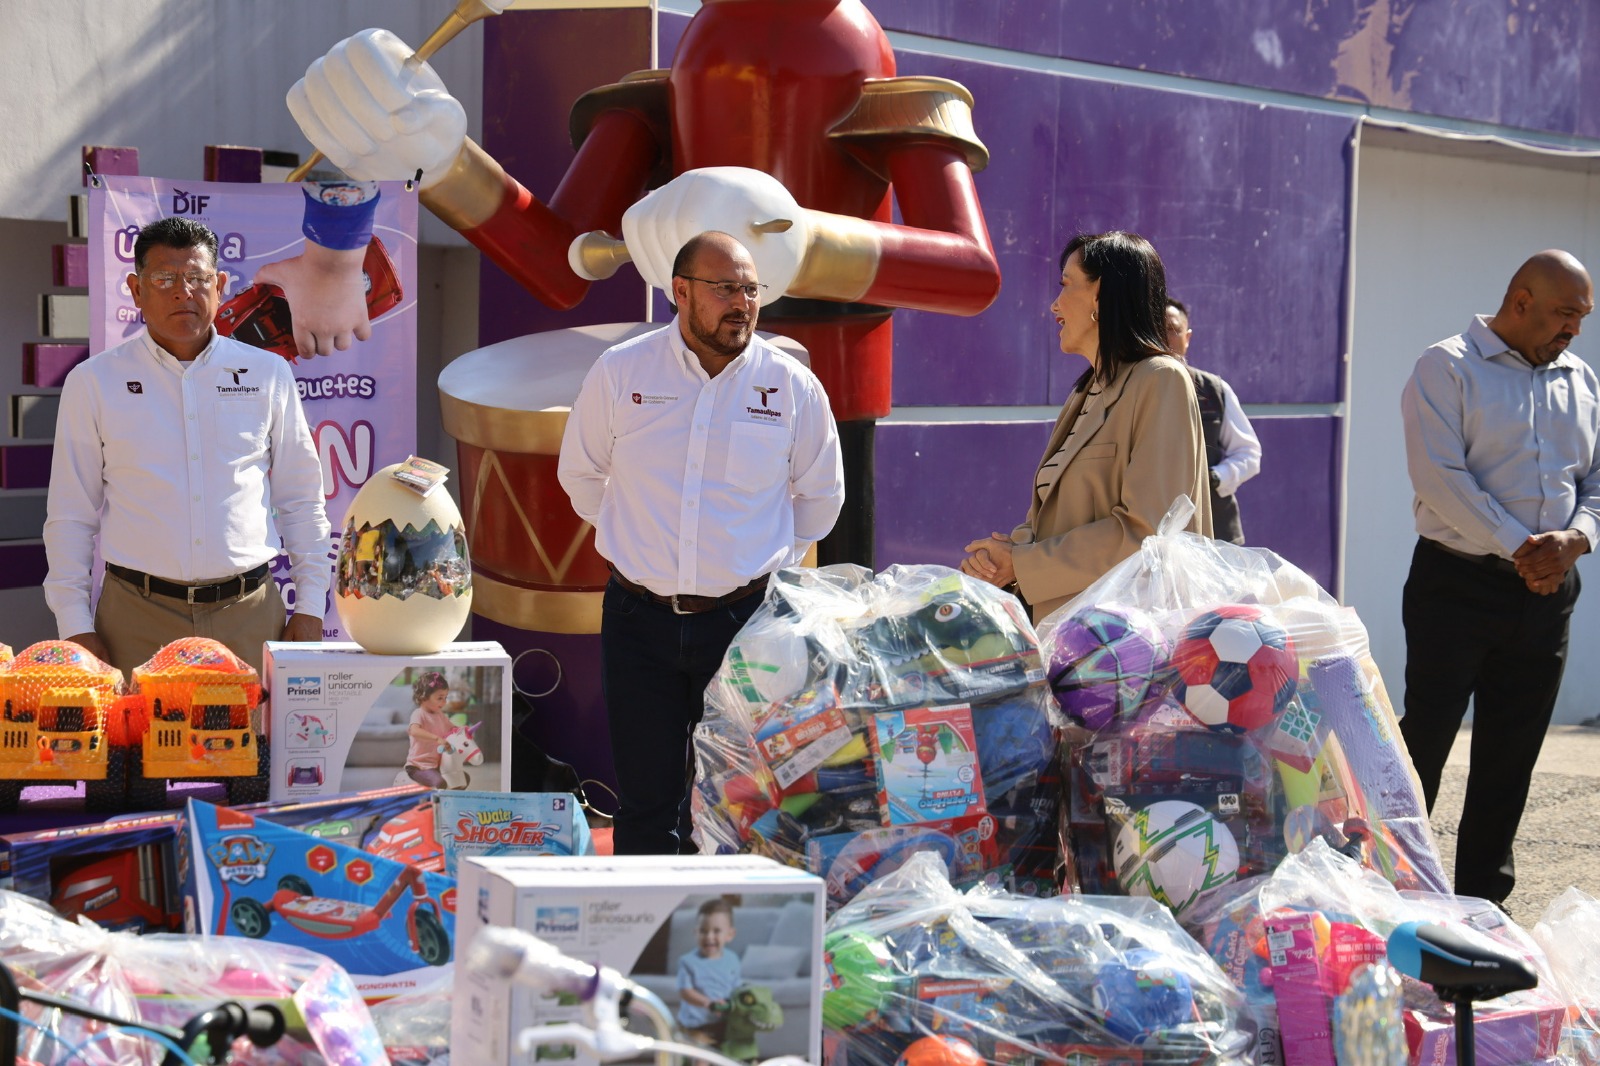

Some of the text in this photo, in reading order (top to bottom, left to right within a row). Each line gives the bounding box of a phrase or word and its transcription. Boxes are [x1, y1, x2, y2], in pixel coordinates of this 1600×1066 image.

[216, 385, 260, 394] Tamaulipas
[298, 375, 374, 398] guetes
[747, 407, 781, 417] Tamaulipas
[328, 672, 354, 681] roller
[328, 681, 373, 690] unicornio
[287, 687, 321, 696] Prinsel
[554, 799, 564, 810] 3+
[1105, 805, 1131, 815] Voit
[206, 842, 276, 868] PAW
[225, 866, 261, 875] PATROL
[536, 921, 579, 933] Prinsel
[1225, 931, 1239, 959] Catch
